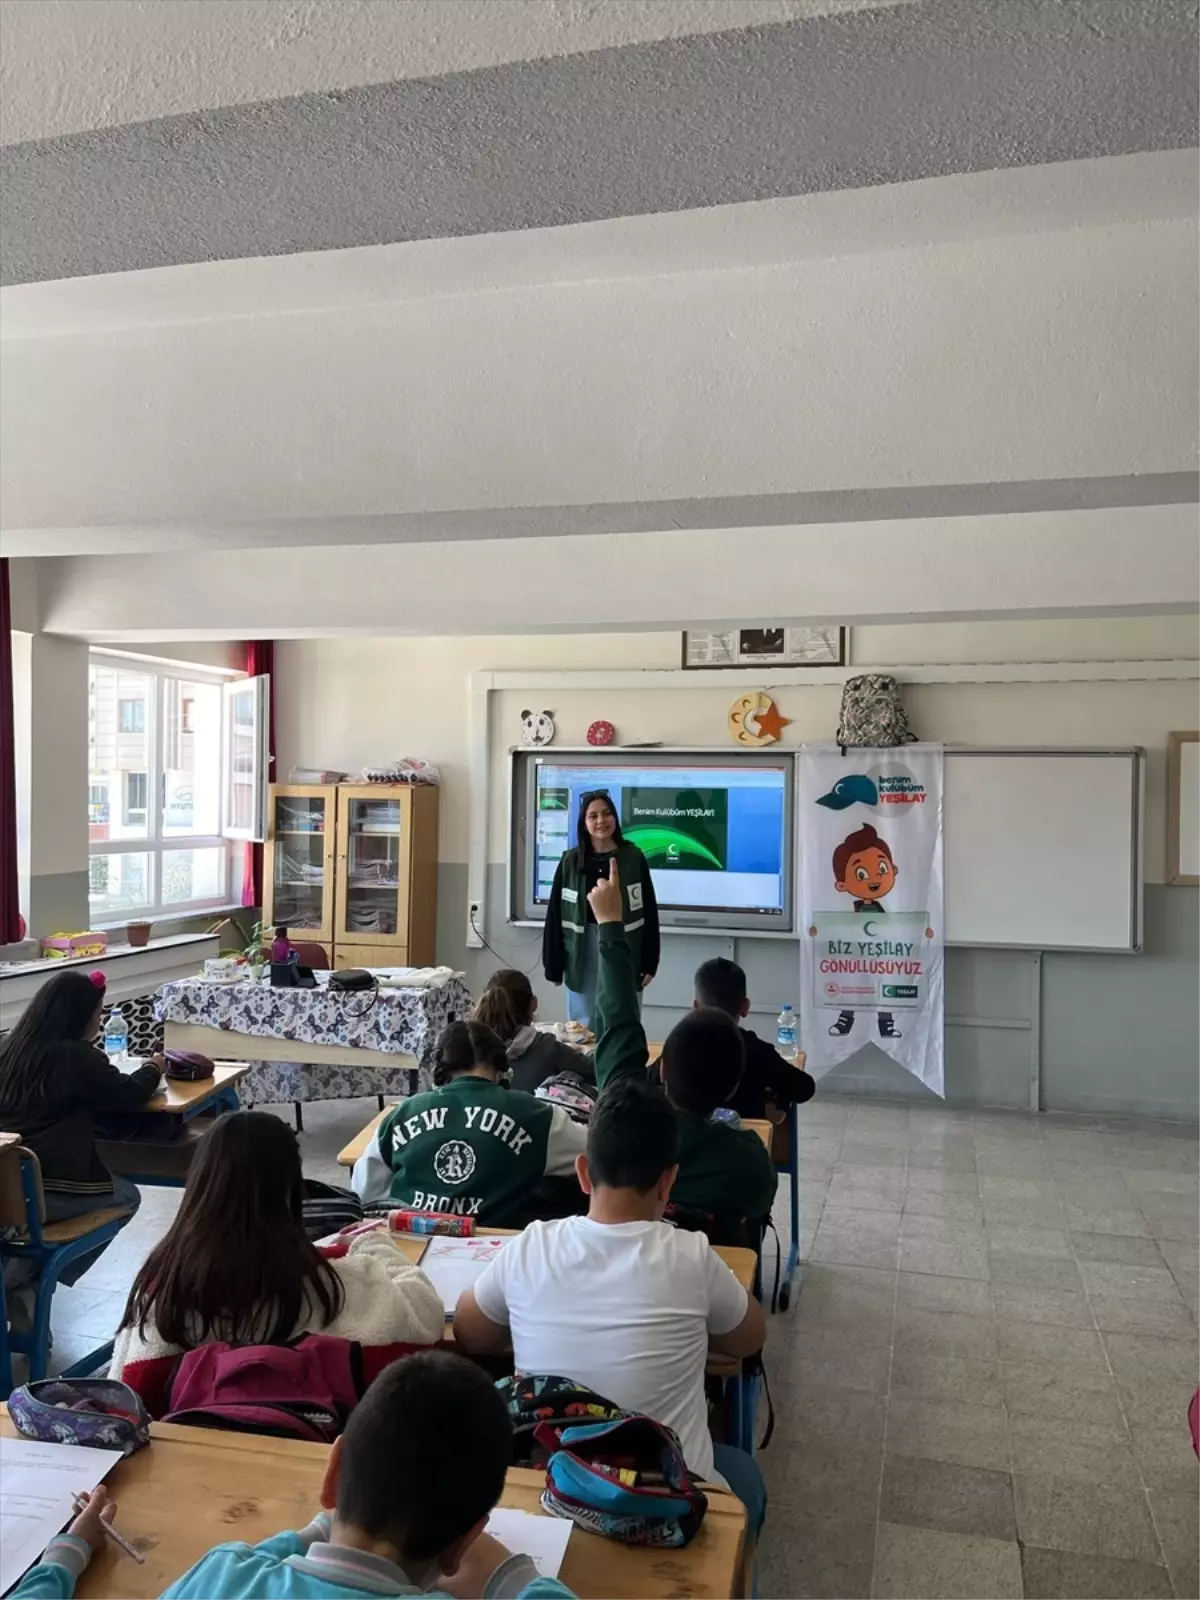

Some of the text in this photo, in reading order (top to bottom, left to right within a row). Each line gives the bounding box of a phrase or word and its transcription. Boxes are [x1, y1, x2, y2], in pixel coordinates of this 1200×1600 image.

[878, 775, 912, 785] benim
[879, 792, 927, 804] YEŞİLAY
[633, 807, 656, 816] Benim
[656, 807, 686, 817] Kulübüm
[828, 938, 914, 957] BİZ YEŞİLAY
[819, 958, 923, 976] GÖNÜLLÜSÜYÜZ
[391, 1106, 533, 1156] NEW YORK
[411, 1190, 484, 1215] BRONX
